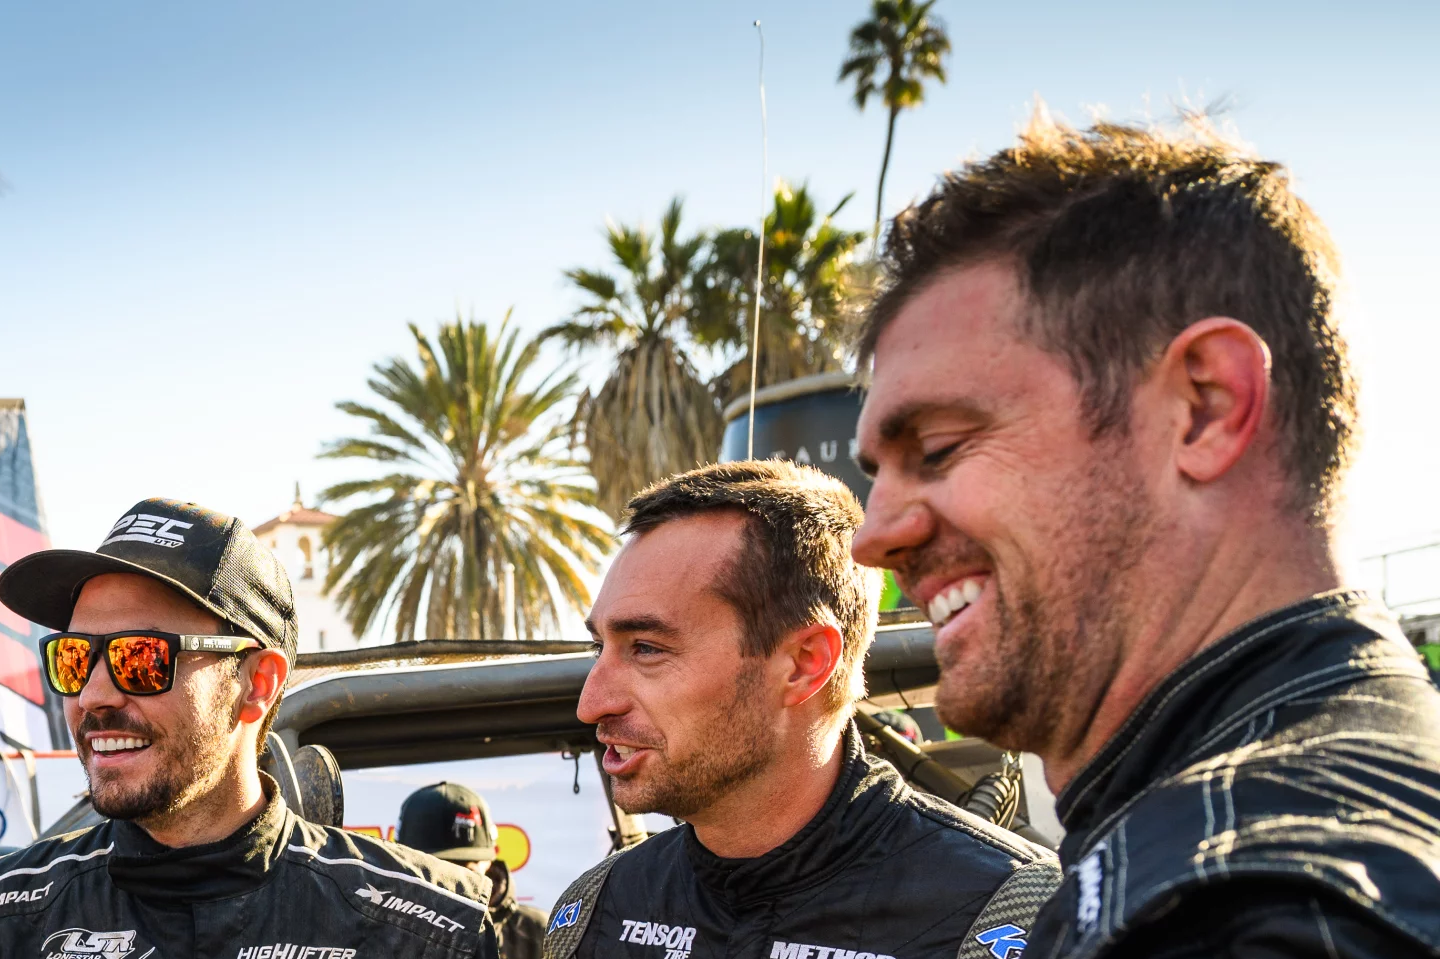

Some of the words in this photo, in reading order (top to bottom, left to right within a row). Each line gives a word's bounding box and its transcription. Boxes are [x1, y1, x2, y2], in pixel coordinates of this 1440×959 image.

[154, 538, 179, 547] UTV
[383, 896, 466, 934] IMPACT
[61, 929, 136, 953] LSR
[619, 919, 697, 951] TENSOR
